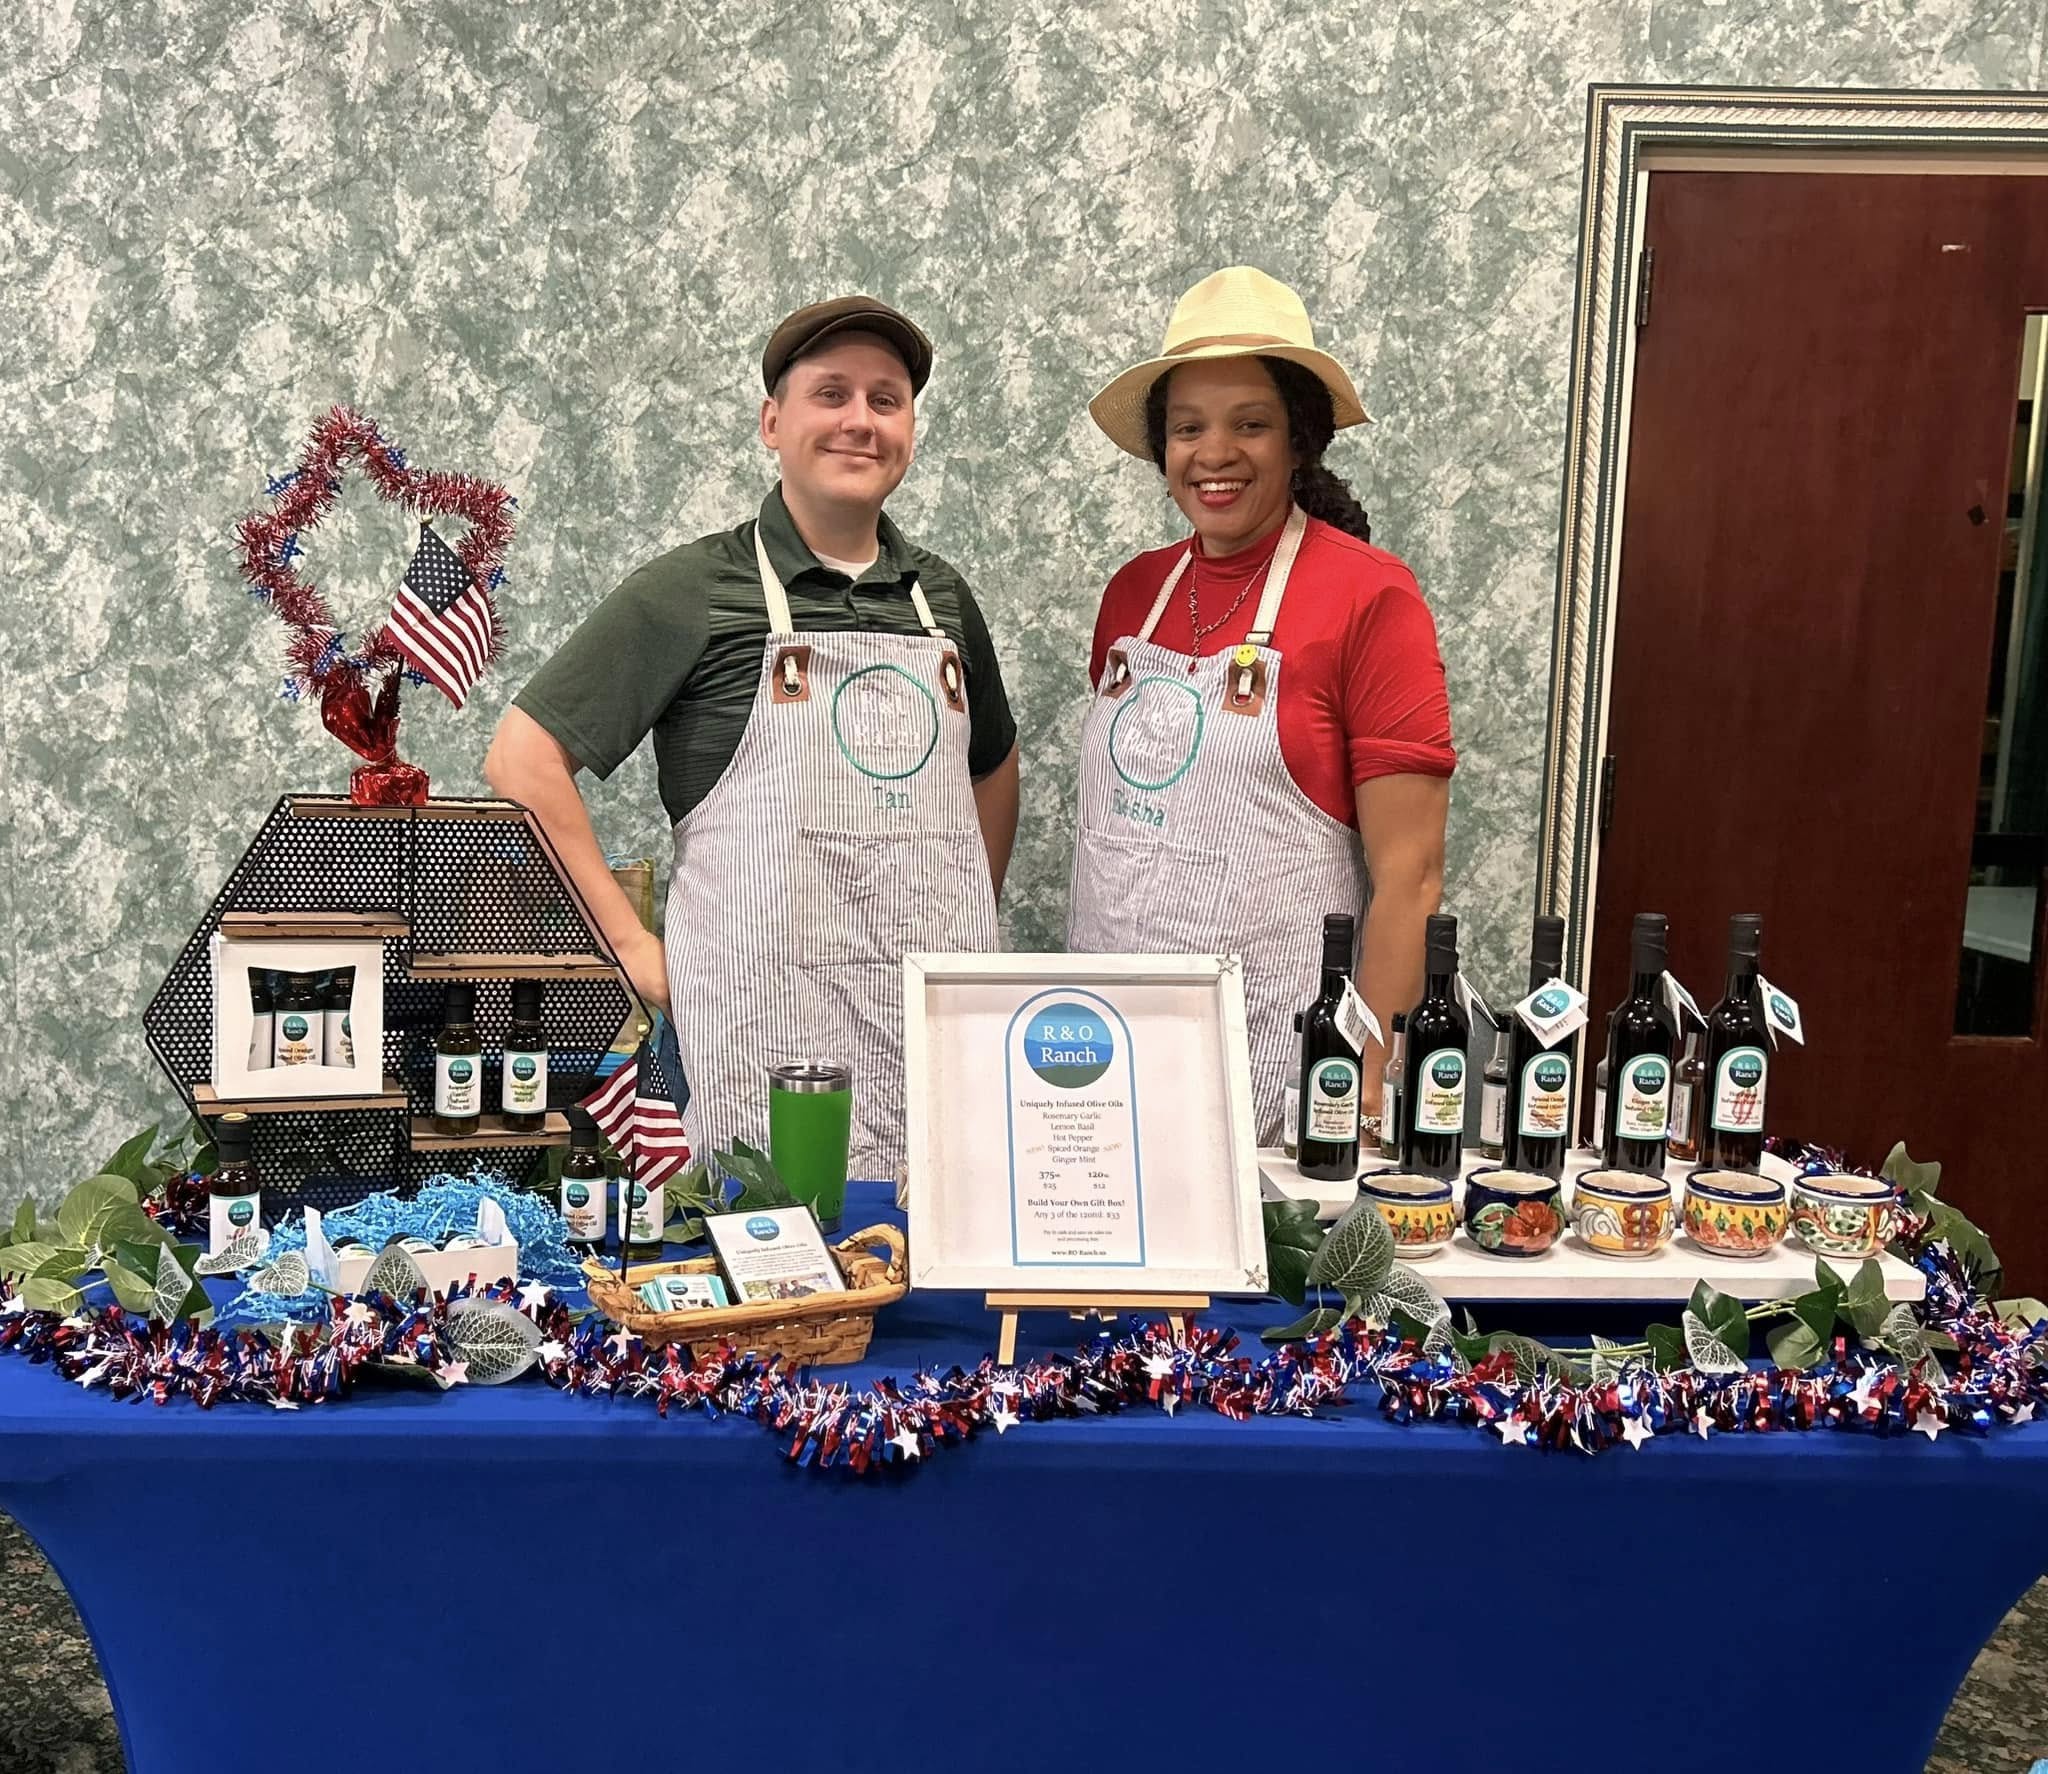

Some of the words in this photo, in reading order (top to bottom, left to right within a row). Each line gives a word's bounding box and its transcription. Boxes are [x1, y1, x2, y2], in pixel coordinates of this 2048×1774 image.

[1536, 999, 1556, 1014] Ranch
[1043, 1025, 1057, 1041] R
[1060, 1025, 1075, 1041] &
[1079, 1025, 1093, 1041] O
[1041, 1047, 1097, 1063] Ranch
[1438, 1071, 1459, 1079] Ranch
[1736, 1070, 1758, 1078] Ranch
[1639, 1077, 1661, 1085] Ranch
[1020, 1100, 1054, 1109] Uniquely
[1056, 1100, 1085, 1108] Infused
[1086, 1100, 1106, 1108] Olive
[1108, 1100, 1124, 1108] Oils
[1043, 1112, 1078, 1121] Rosemary
[1080, 1112, 1102, 1120] Garlic
[1050, 1123, 1076, 1131] Lemon
[1078, 1123, 1095, 1131] Basil
[1068, 1134, 1093, 1143] Pepper
[1047, 1145, 1072, 1154] Spiced
[1073, 1145, 1100, 1154] Orange
[1052, 1156, 1077, 1165] Ginger
[1043, 1182, 1057, 1190] $25
[1027, 1199, 1049, 1207] Build
[1050, 1199, 1068, 1207] Your
[1070, 1199, 1089, 1207] Own
[1090, 1199, 1106, 1207] Gift
[1107, 1199, 1125, 1207] Box!
[1033, 1211, 1049, 1220] Any
[1050, 1212, 1056, 1220] 3
[1057, 1210, 1064, 1218] of
[1066, 1210, 1078, 1218] the
[1106, 1212, 1121, 1220] $33
[753, 1227, 776, 1235] Ranch
